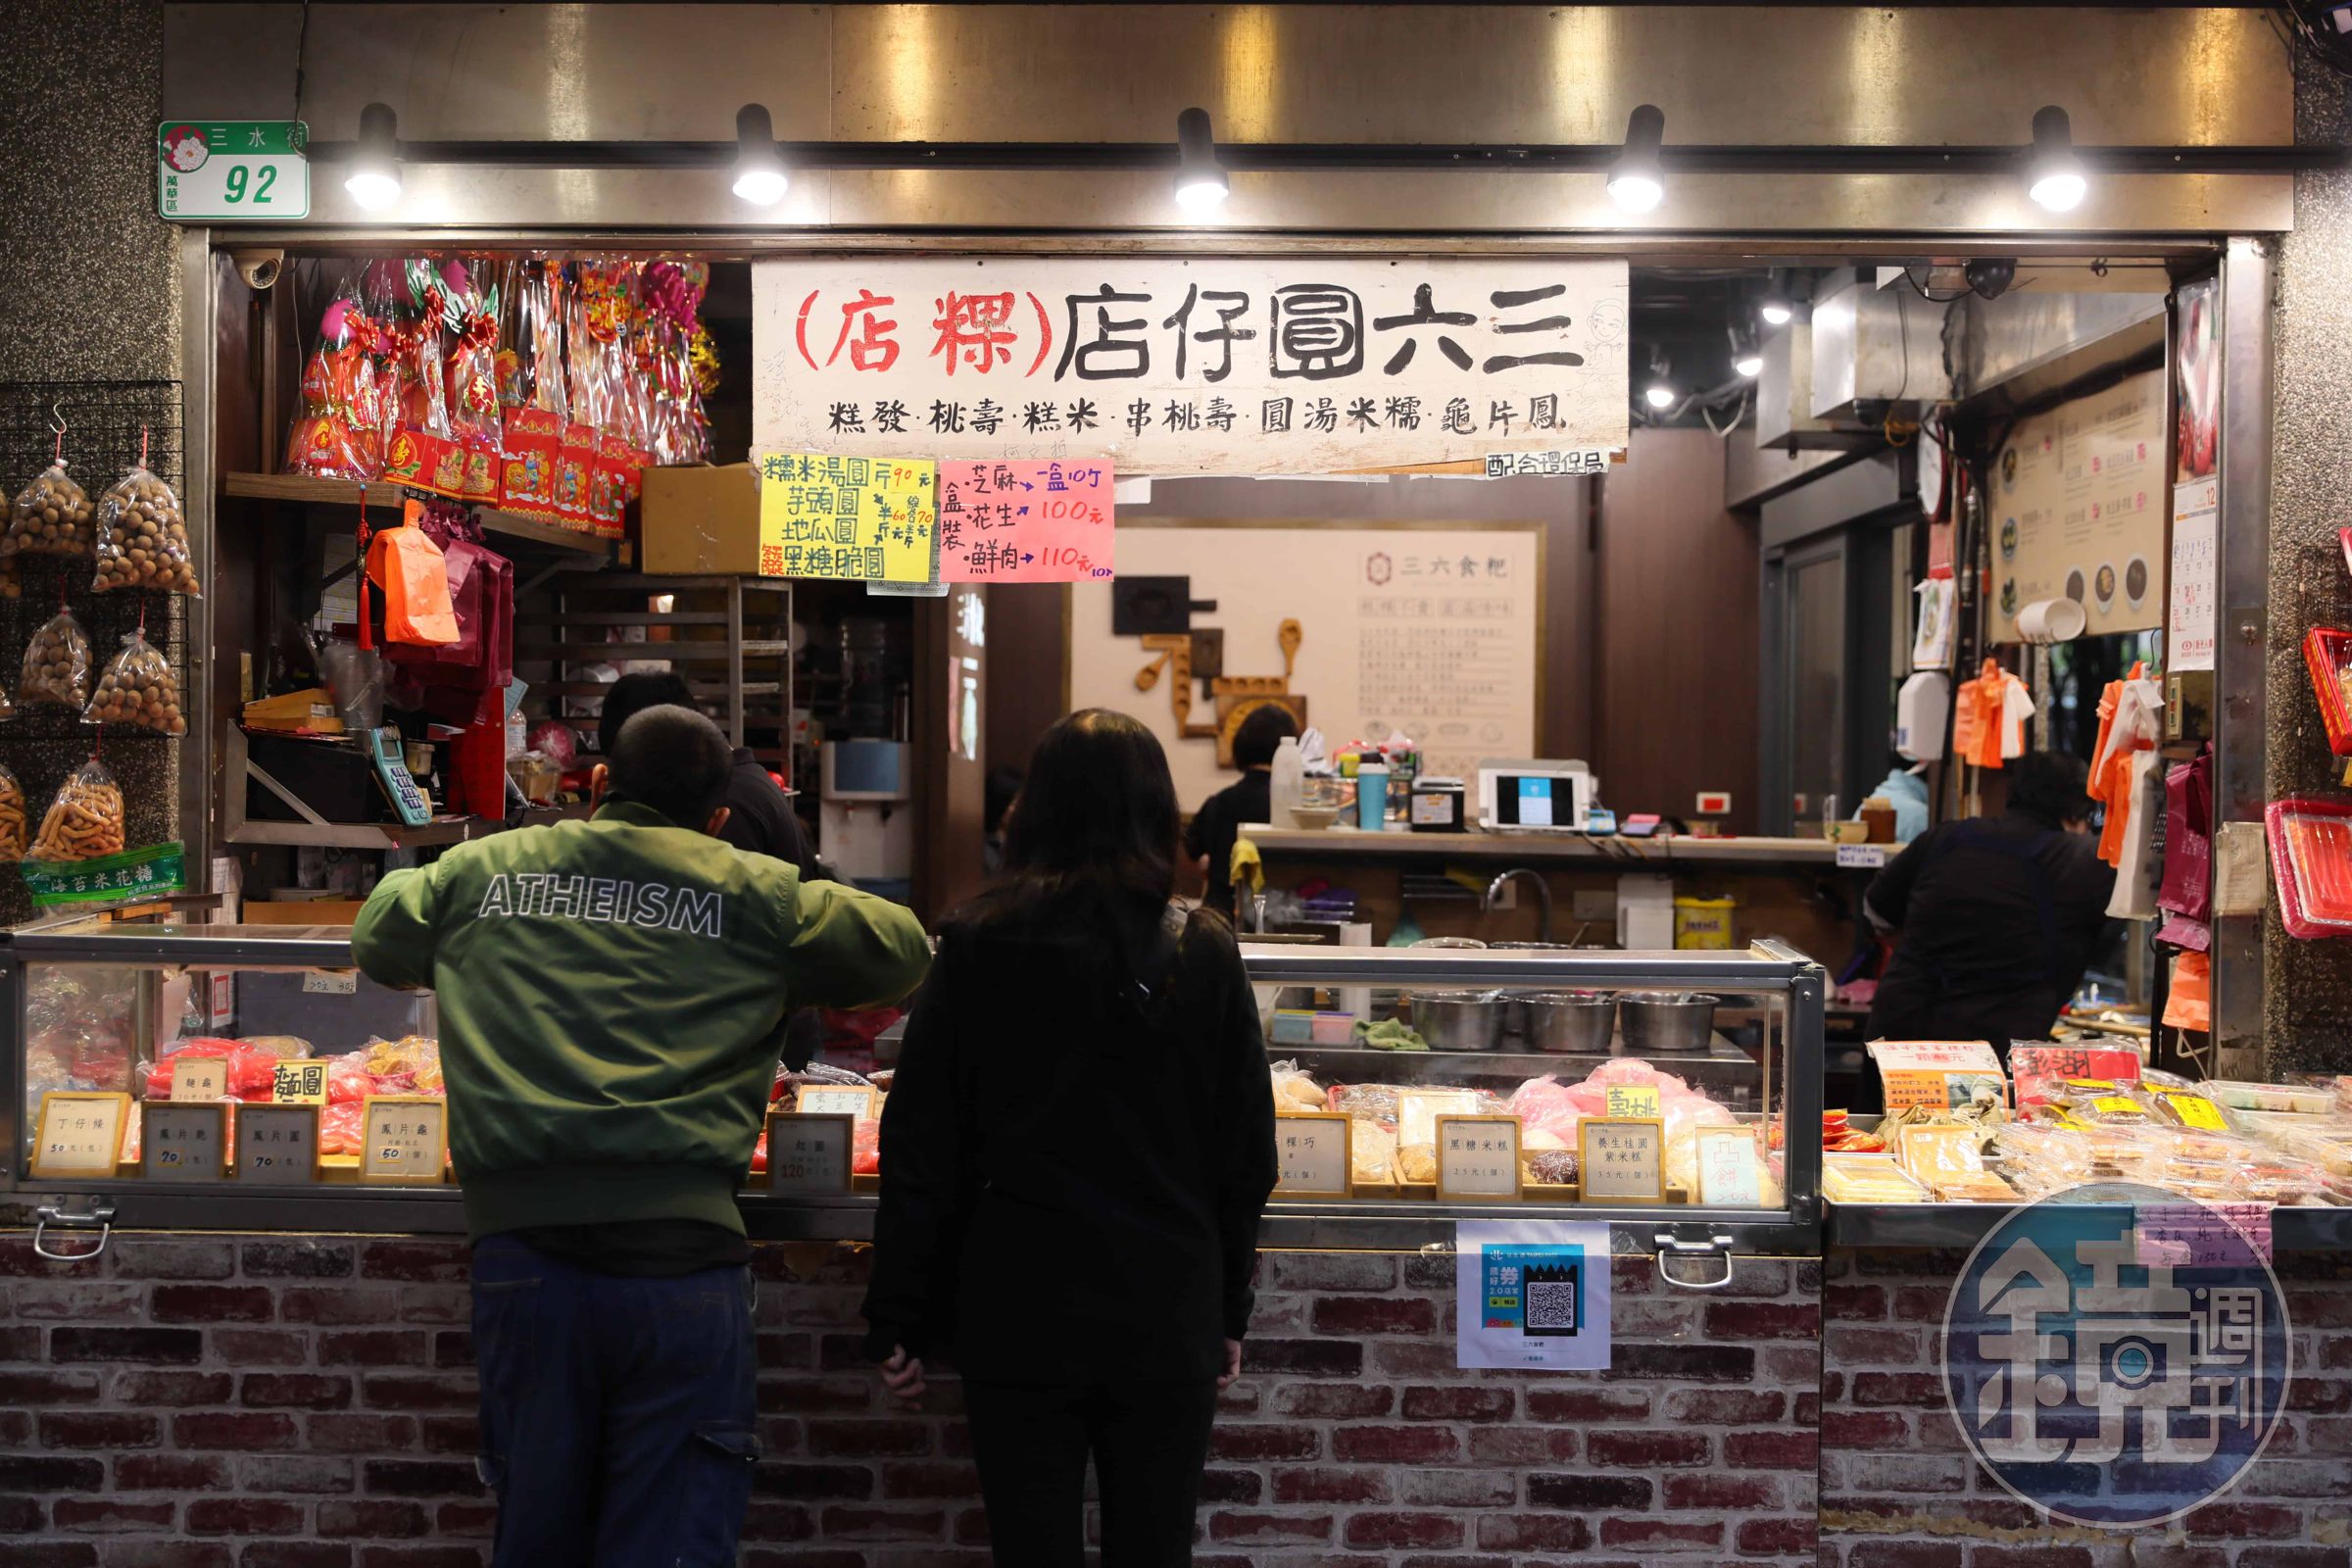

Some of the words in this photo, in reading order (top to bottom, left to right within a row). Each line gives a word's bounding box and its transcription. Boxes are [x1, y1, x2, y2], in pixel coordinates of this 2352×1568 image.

[211, 126, 303, 148] 三水街
[166, 175, 178, 212] 萬華區
[224, 165, 277, 204] 92
[764, 455, 870, 488] 糯米湯圓
[787, 486, 859, 516] 芋頭圓
[2206, 488, 2216, 506] 12
[943, 482, 966, 551] 盒裝
[972, 503, 1016, 530] 花生
[1043, 501, 1104, 524] 100元
[782, 517, 858, 545] 地瓜圓
[785, 545, 885, 578] 黑糖脆圓
[970, 539, 1018, 574] 鮮肉
[1043, 547, 1094, 572] 110元
[50, 865, 154, 893] 海苔米花糖
[478, 873, 722, 938] ATHEISM
[274, 1064, 323, 1099] 麵圓
[1449, 1139, 1508, 1152] 黑糖米糕
[1597, 1137, 1648, 1150] 養生桂圓
